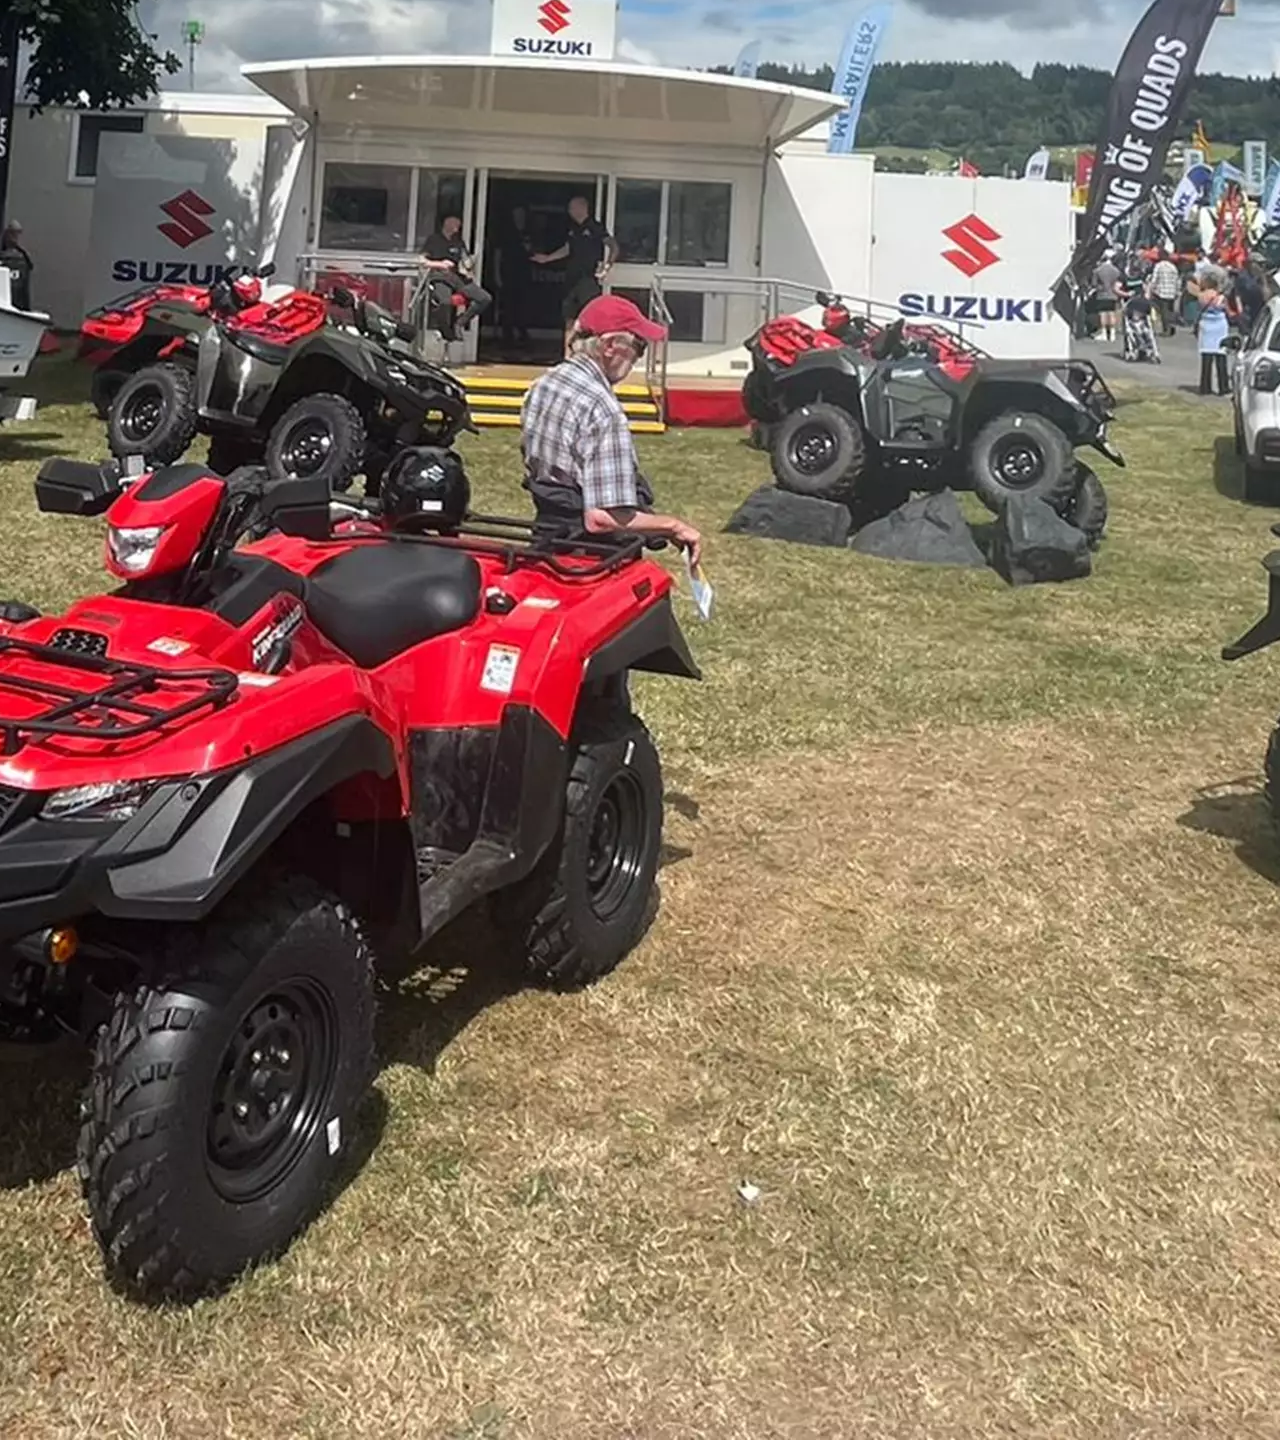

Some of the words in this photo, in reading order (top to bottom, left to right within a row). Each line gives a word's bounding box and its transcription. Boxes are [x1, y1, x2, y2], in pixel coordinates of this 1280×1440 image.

[513, 37, 593, 56] SUZUKI
[1130, 34, 1188, 132] QUADS
[1117, 133, 1154, 175] OF
[898, 293, 1043, 323] SUZUKI
